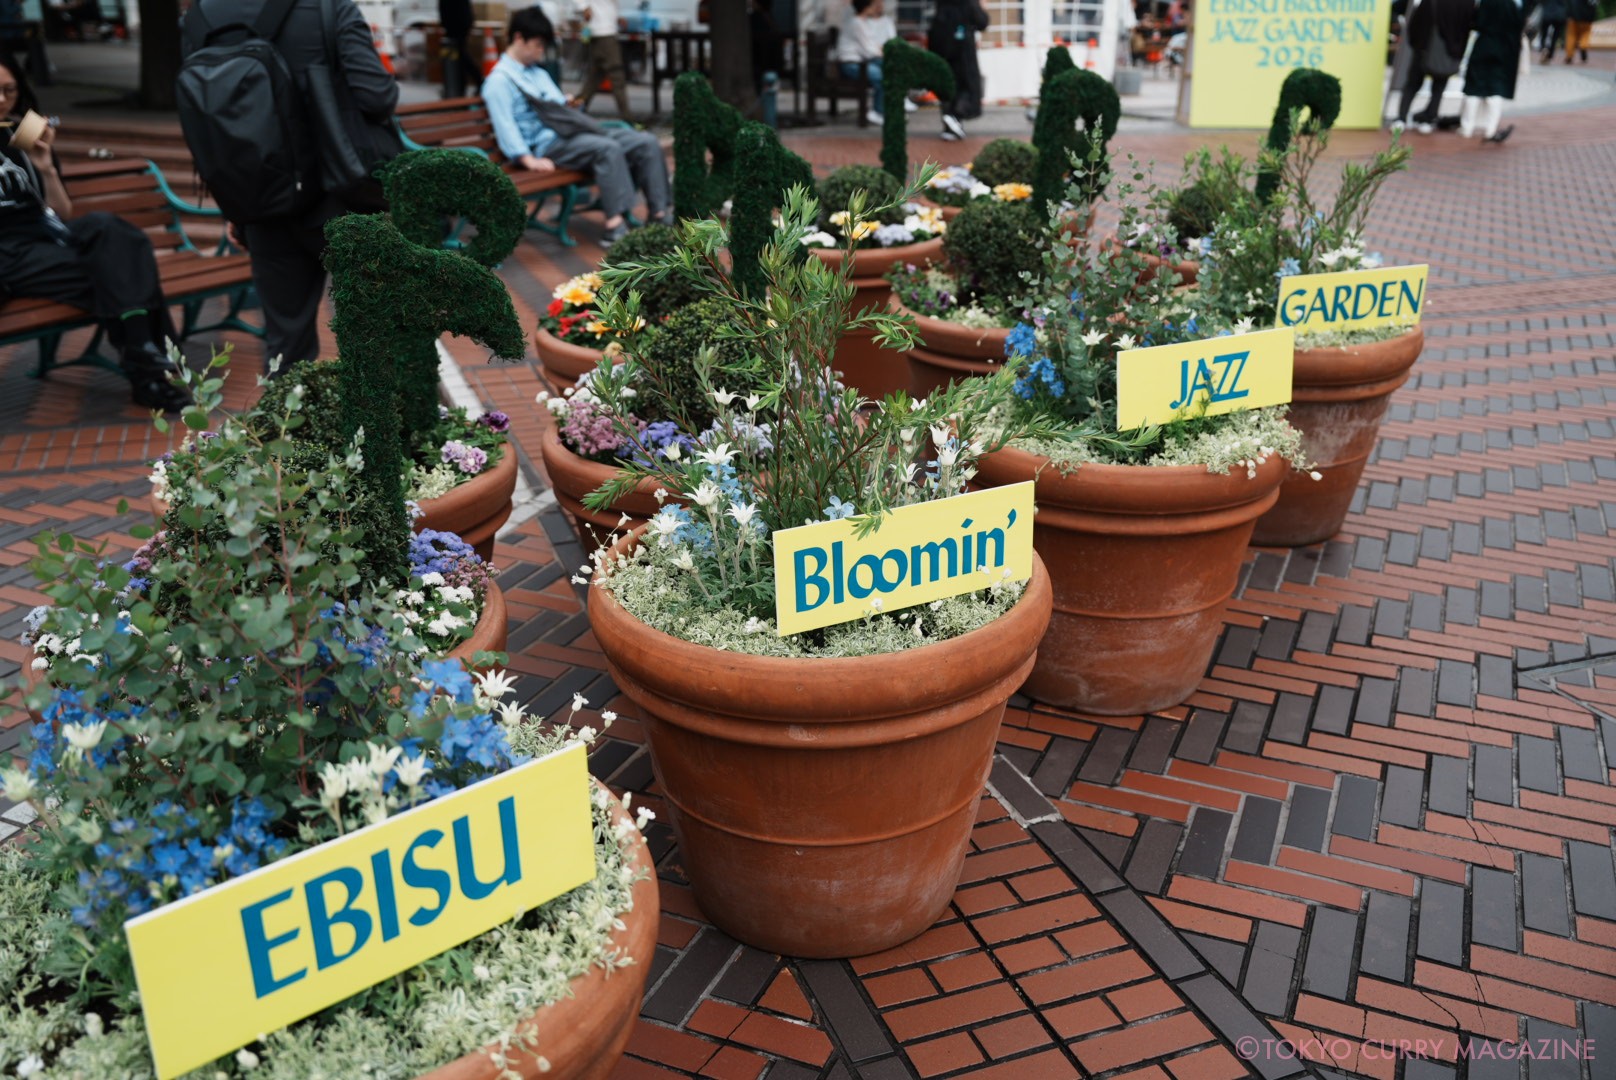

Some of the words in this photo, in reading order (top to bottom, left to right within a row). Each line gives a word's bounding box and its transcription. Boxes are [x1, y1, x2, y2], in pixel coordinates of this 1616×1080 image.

[1208, 18, 1260, 44] JAZZ
[1263, 18, 1374, 43] GARDEN
[1257, 46, 1324, 68] 2026
[1280, 278, 1424, 327] GARDEN
[1169, 351, 1250, 410] JAZZ
[794, 508, 1017, 613] Bloomin'
[240, 796, 522, 999] EBISU
